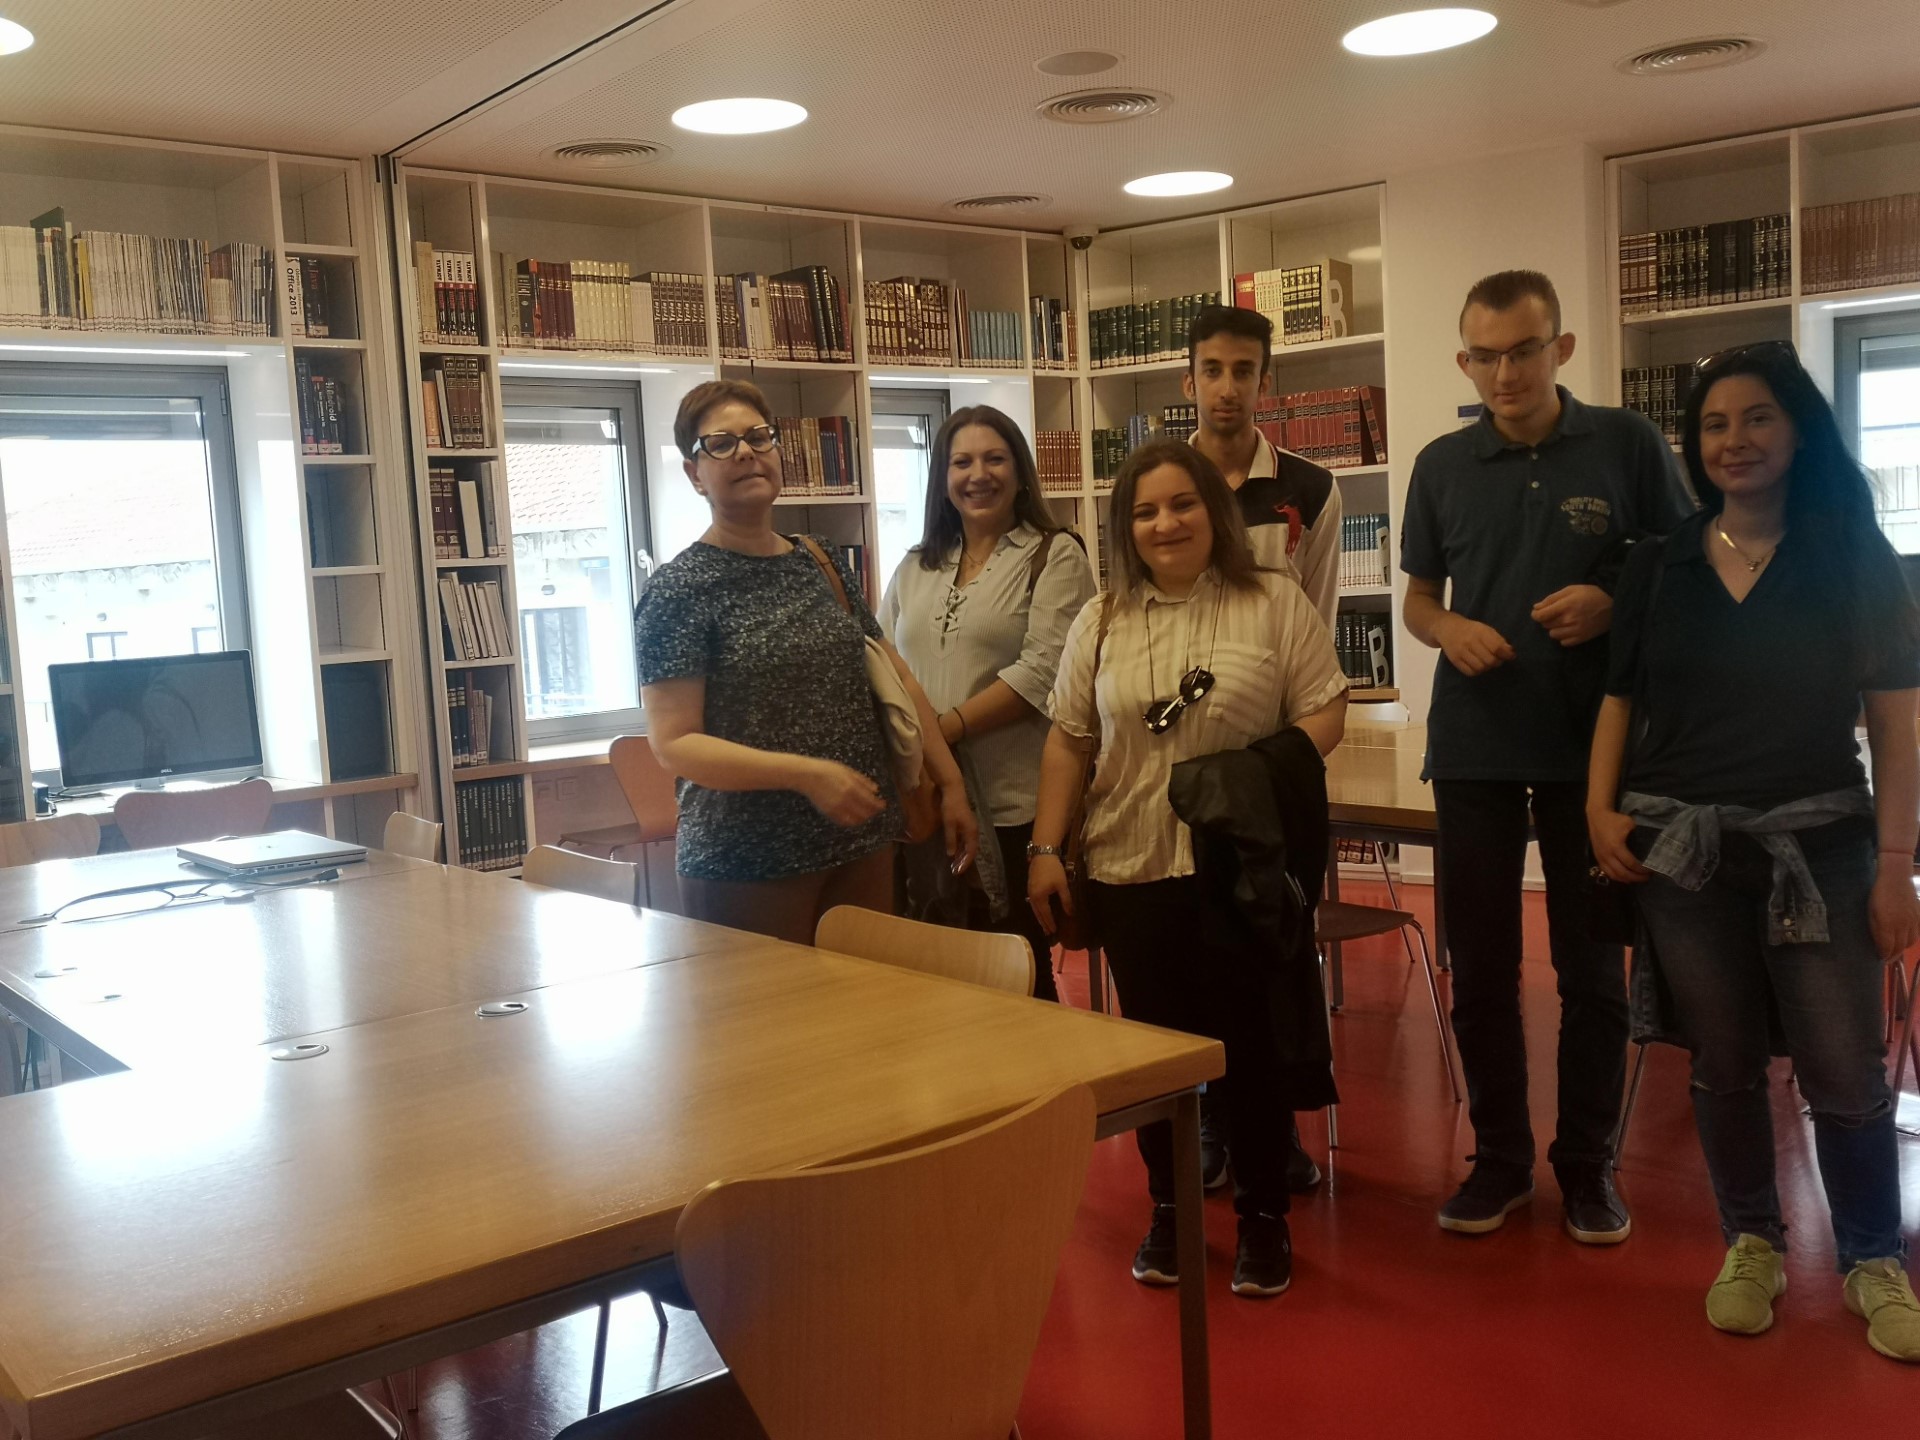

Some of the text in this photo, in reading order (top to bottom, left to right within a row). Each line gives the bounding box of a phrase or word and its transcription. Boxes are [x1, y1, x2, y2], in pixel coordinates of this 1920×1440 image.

[286, 268, 298, 315] Office 2013
[308, 269, 319, 290] Java
[326, 389, 337, 422] Android
